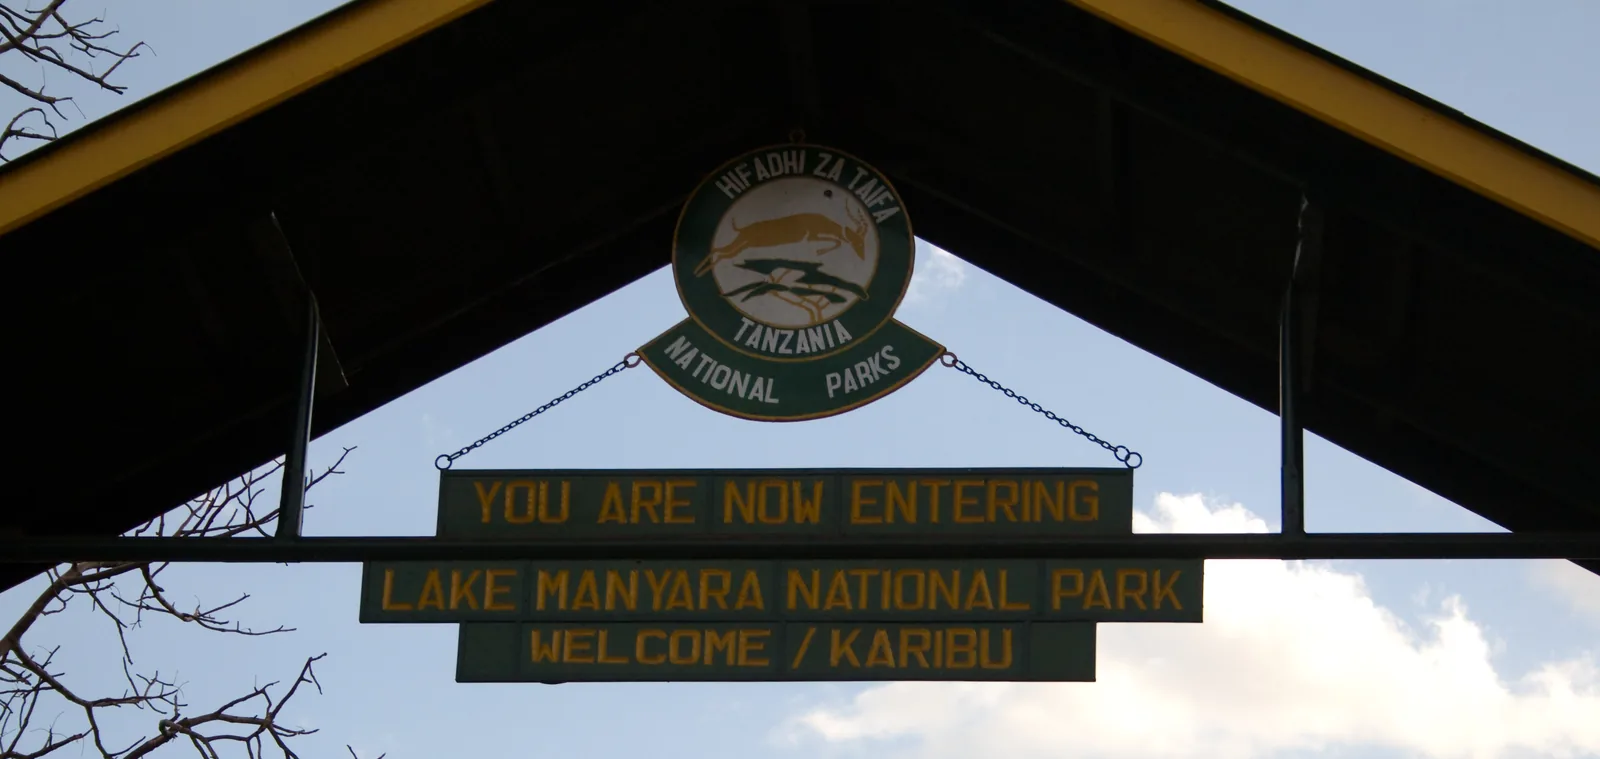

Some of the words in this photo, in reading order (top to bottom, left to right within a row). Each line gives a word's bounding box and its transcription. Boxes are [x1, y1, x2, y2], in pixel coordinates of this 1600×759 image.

[715, 150, 806, 199] HIFADHI
[813, 153, 845, 182] ZA
[848, 167, 900, 224] TAIFA
[733, 317, 853, 355] TANZANIA
[664, 335, 779, 404] NATIONAL
[826, 345, 901, 399] PARKS
[474, 480, 570, 524] YOU
[597, 480, 697, 524] ARE
[723, 480, 824, 524] NOW
[850, 479, 1099, 524] ENTERING
[382, 569, 518, 611] LAKE
[536, 569, 765, 611] MANYARA
[787, 568, 1030, 611] NATIONAL
[1051, 568, 1183, 611] PARK
[531, 628, 771, 667] WELCOME
[792, 627, 817, 669] /
[830, 628, 1013, 669] KARIBU
